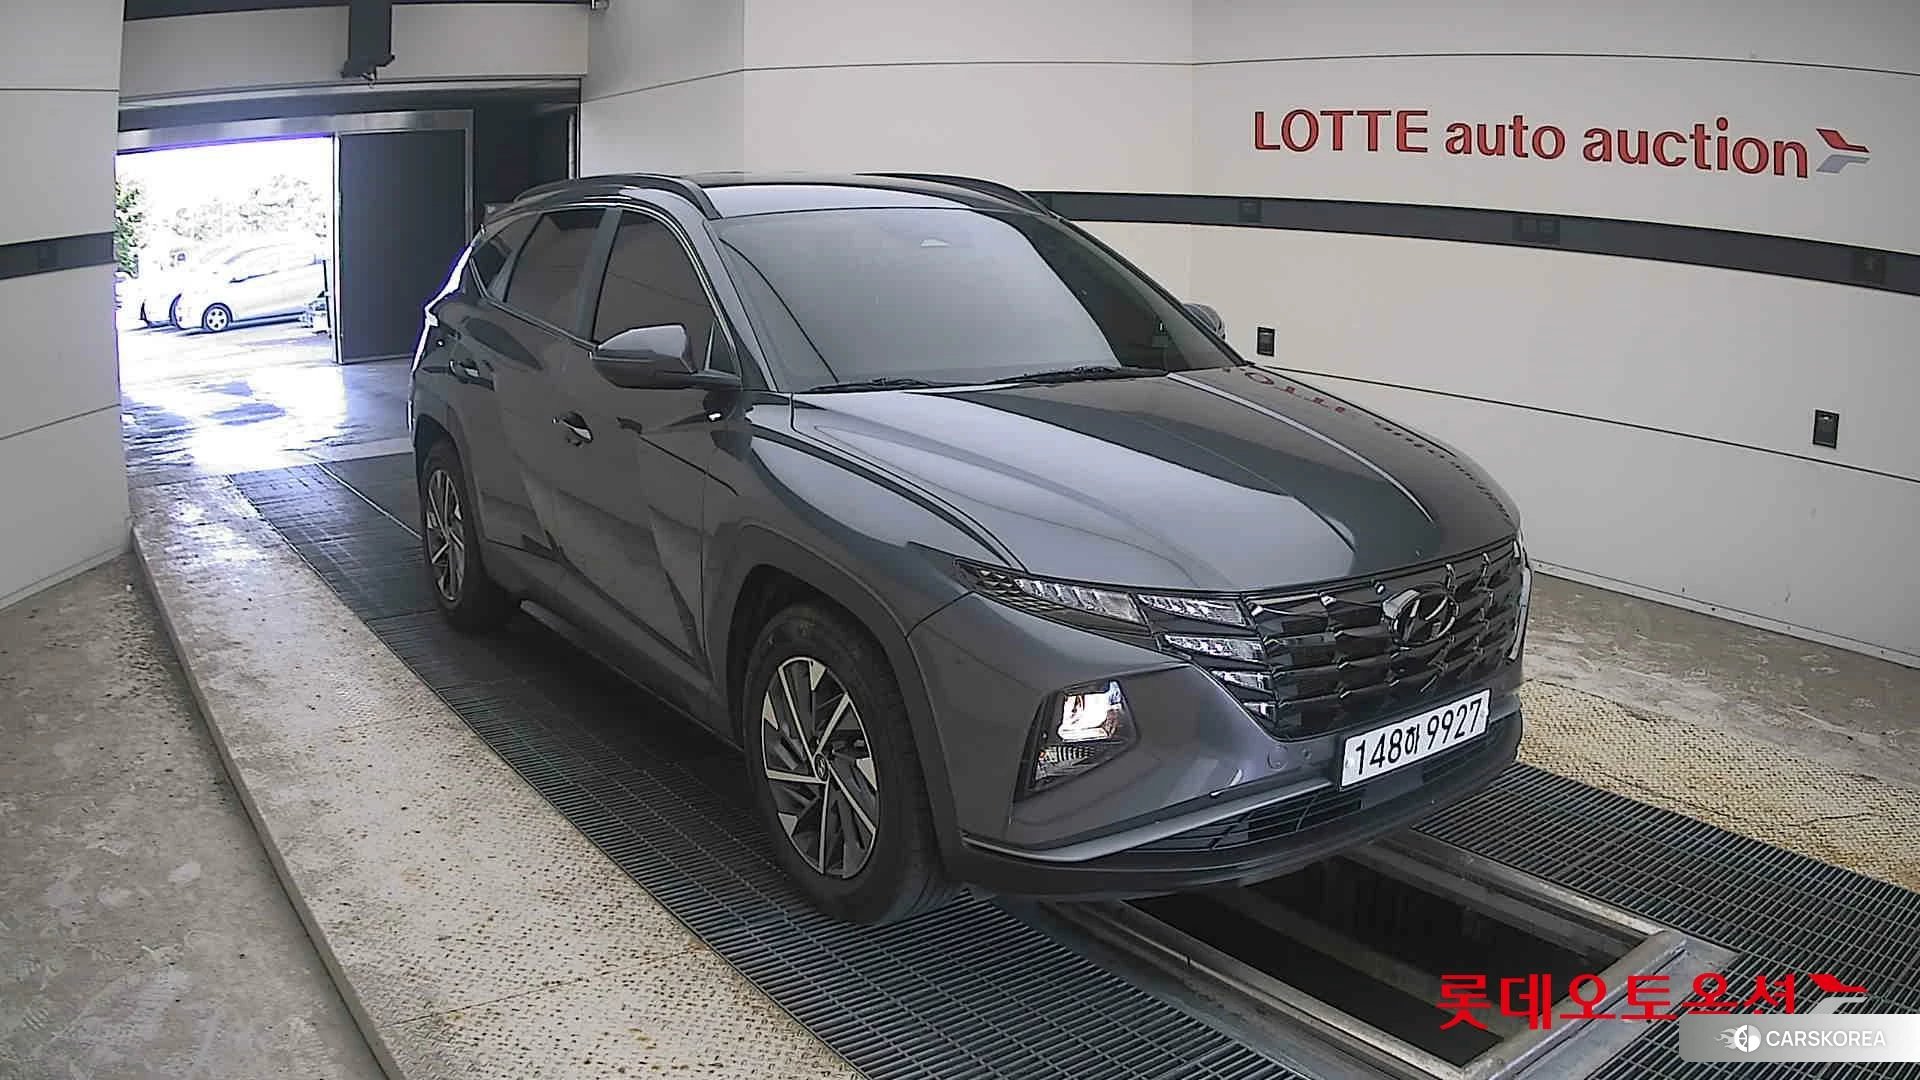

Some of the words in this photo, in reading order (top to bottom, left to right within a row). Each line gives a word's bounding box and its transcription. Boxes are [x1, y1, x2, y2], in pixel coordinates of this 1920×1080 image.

[1254, 109, 1430, 154] LOTTE
[1444, 115, 1567, 161] auto
[1582, 116, 1809, 178] auction
[1355, 723, 1421, 776] 148하
[1426, 697, 1483, 751] 9927
